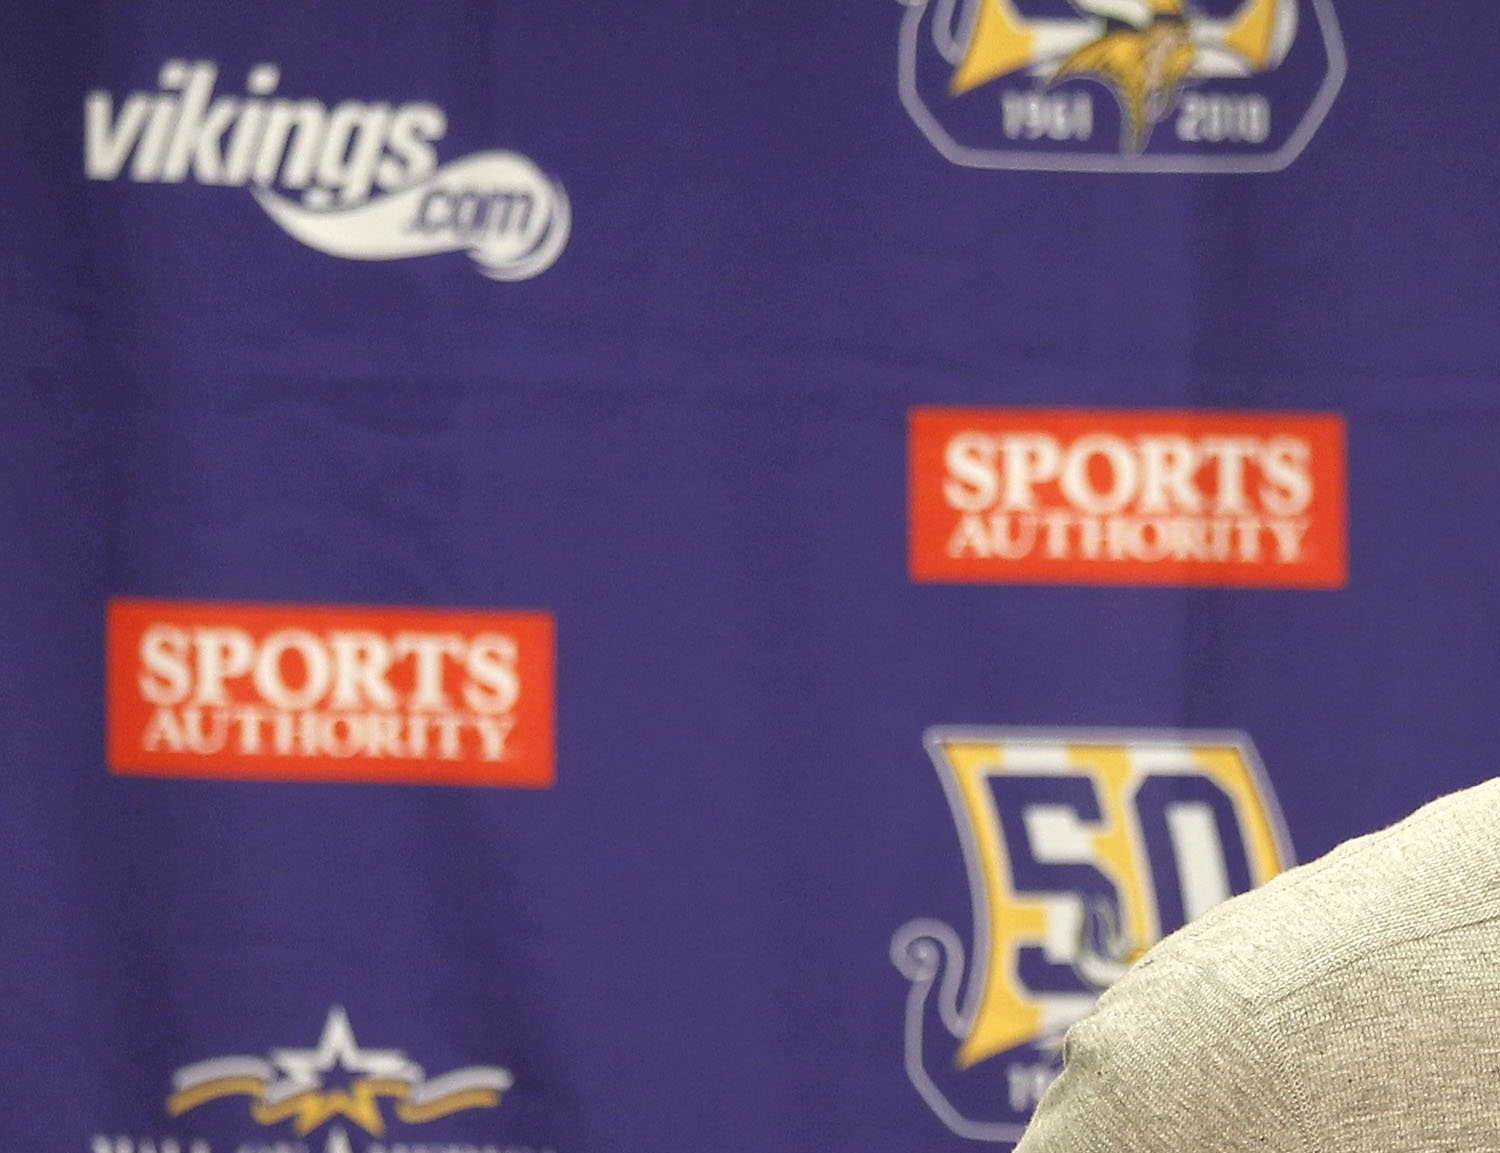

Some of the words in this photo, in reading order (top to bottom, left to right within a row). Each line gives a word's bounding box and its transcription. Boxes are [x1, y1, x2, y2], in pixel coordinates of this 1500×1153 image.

[943, 430, 1314, 518] SPORTS
[946, 510, 1310, 564] AUTHORITY
[139, 623, 520, 714] SPORTS
[142, 705, 516, 763] AUTHORITY
